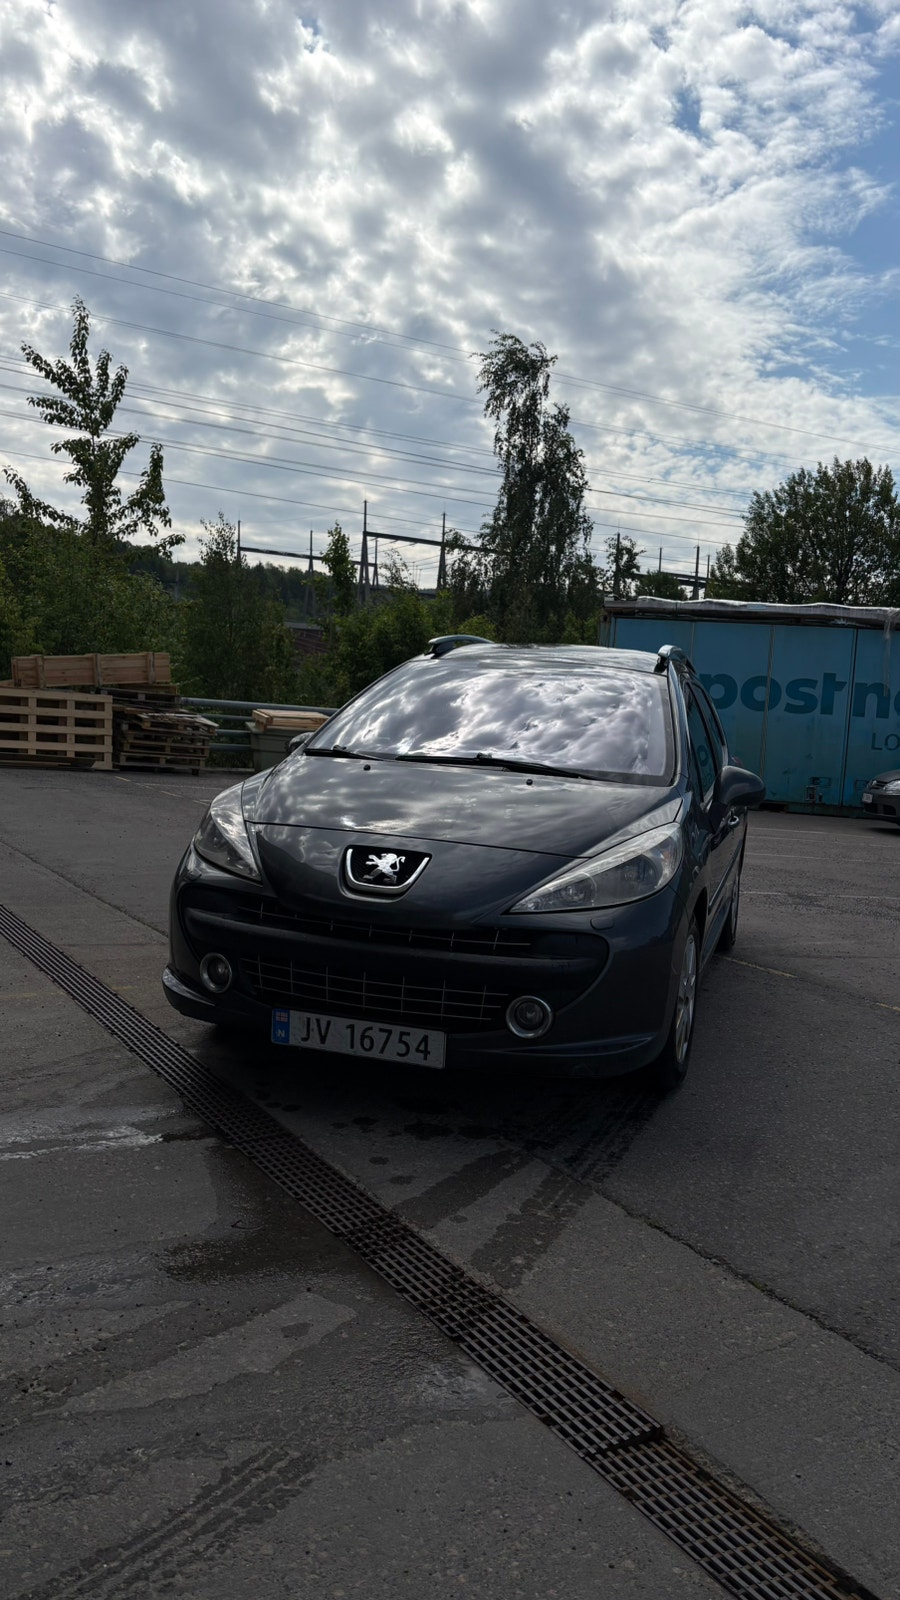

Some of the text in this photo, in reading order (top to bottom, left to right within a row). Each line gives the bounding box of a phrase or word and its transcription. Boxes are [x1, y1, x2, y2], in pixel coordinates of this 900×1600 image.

[276, 1029, 286, 1038] N
[301, 1017, 431, 1061] JV 16754
